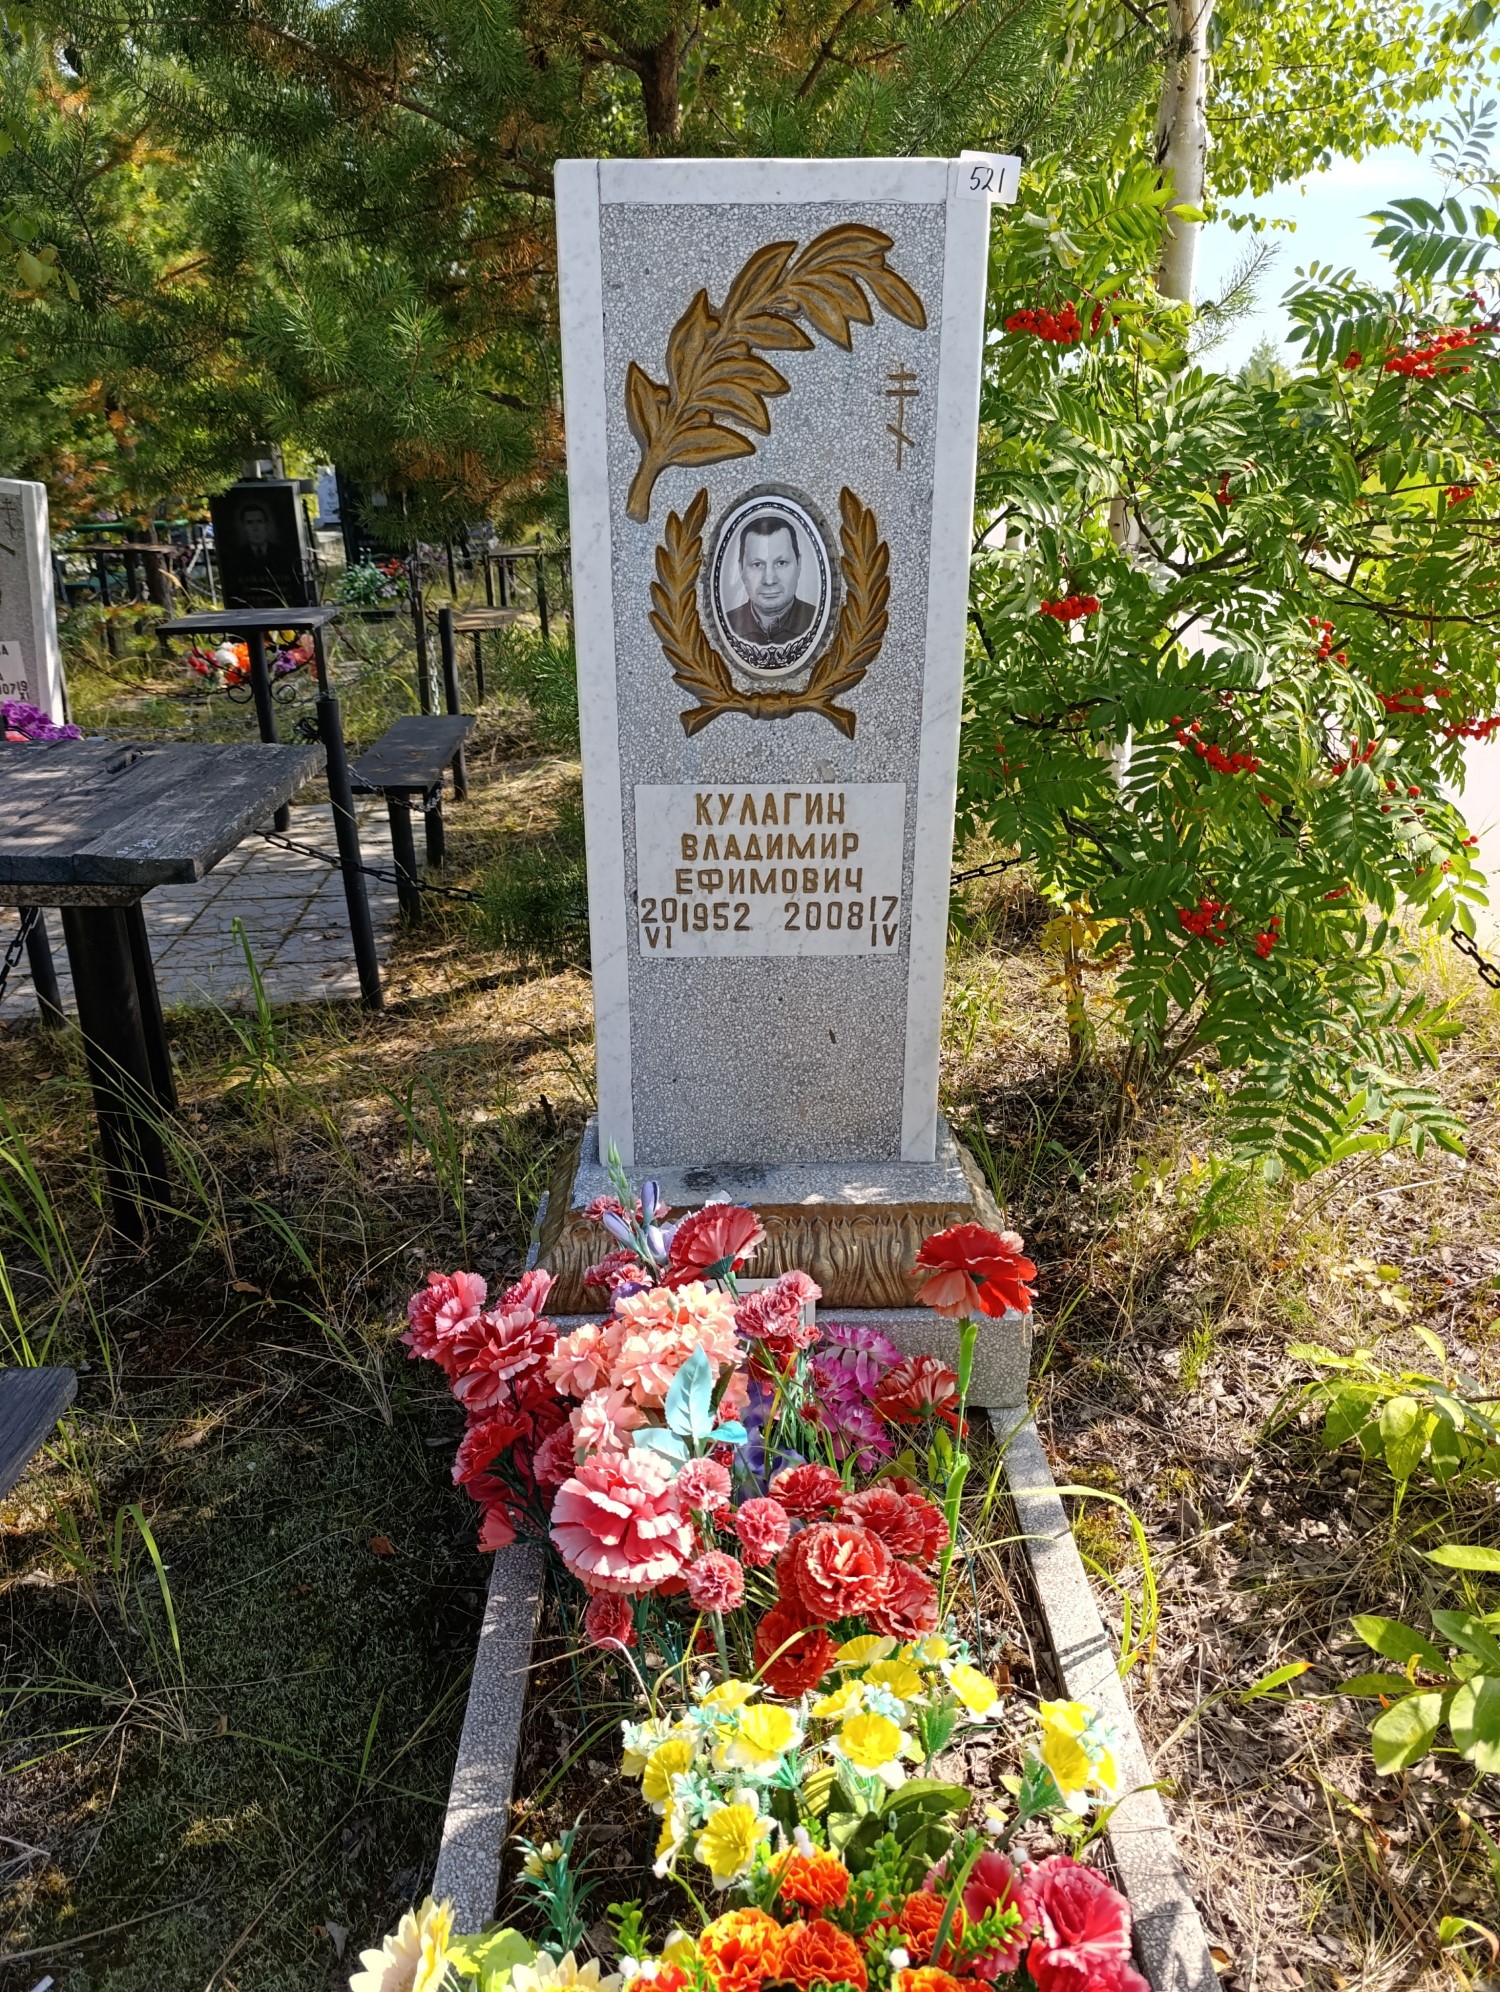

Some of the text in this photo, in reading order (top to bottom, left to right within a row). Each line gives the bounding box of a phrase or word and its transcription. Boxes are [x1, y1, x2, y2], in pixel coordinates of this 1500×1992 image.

[970, 166, 1005, 193] 521
[695, 792, 845, 826] КУЛАГИН
[681, 833, 859, 862] ВЛАДИМИР
[675, 868, 863, 895] ЕФИМОВИЧ
[640, 896, 899, 932] 20 1952 2008 17
[644, 923, 899, 949] VI IV
